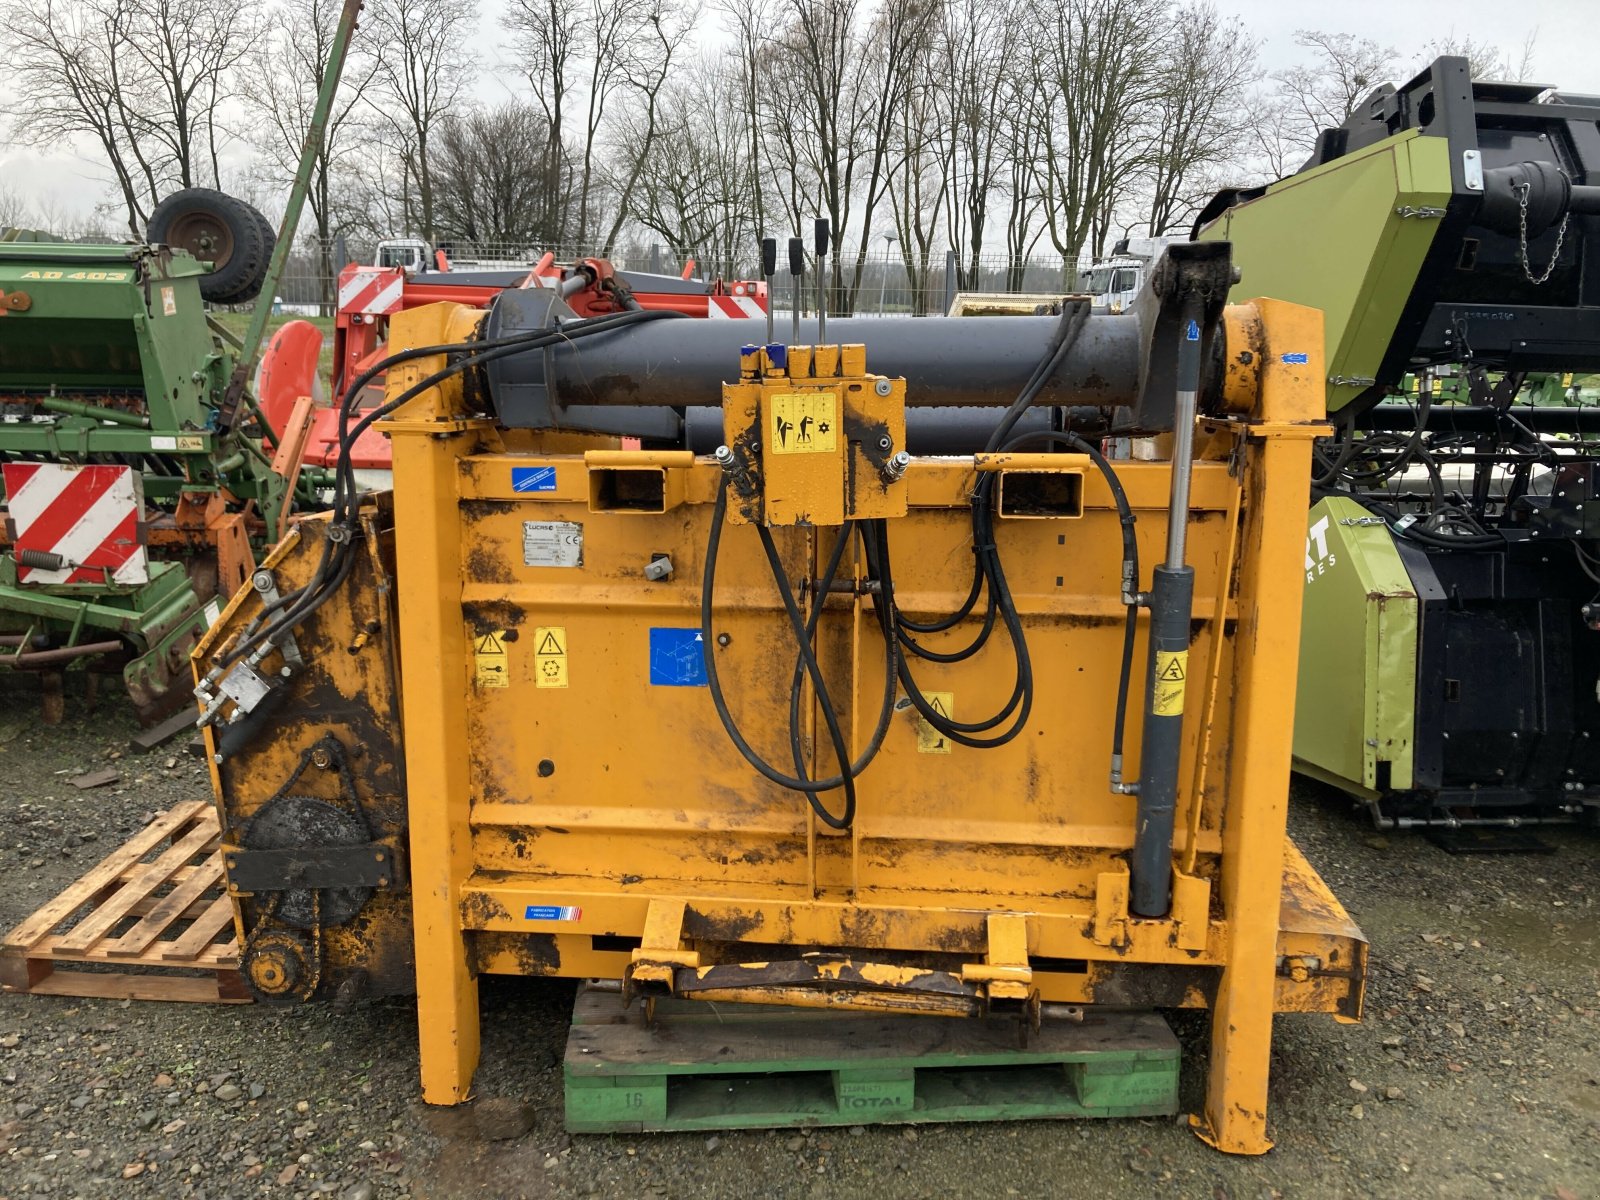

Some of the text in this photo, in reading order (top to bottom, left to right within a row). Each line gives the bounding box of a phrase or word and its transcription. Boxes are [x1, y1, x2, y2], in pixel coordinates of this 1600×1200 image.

[20, 271, 127, 280] AD 403
[625, 1092, 643, 1109] 16
[840, 1095, 908, 1109] TOTAL
